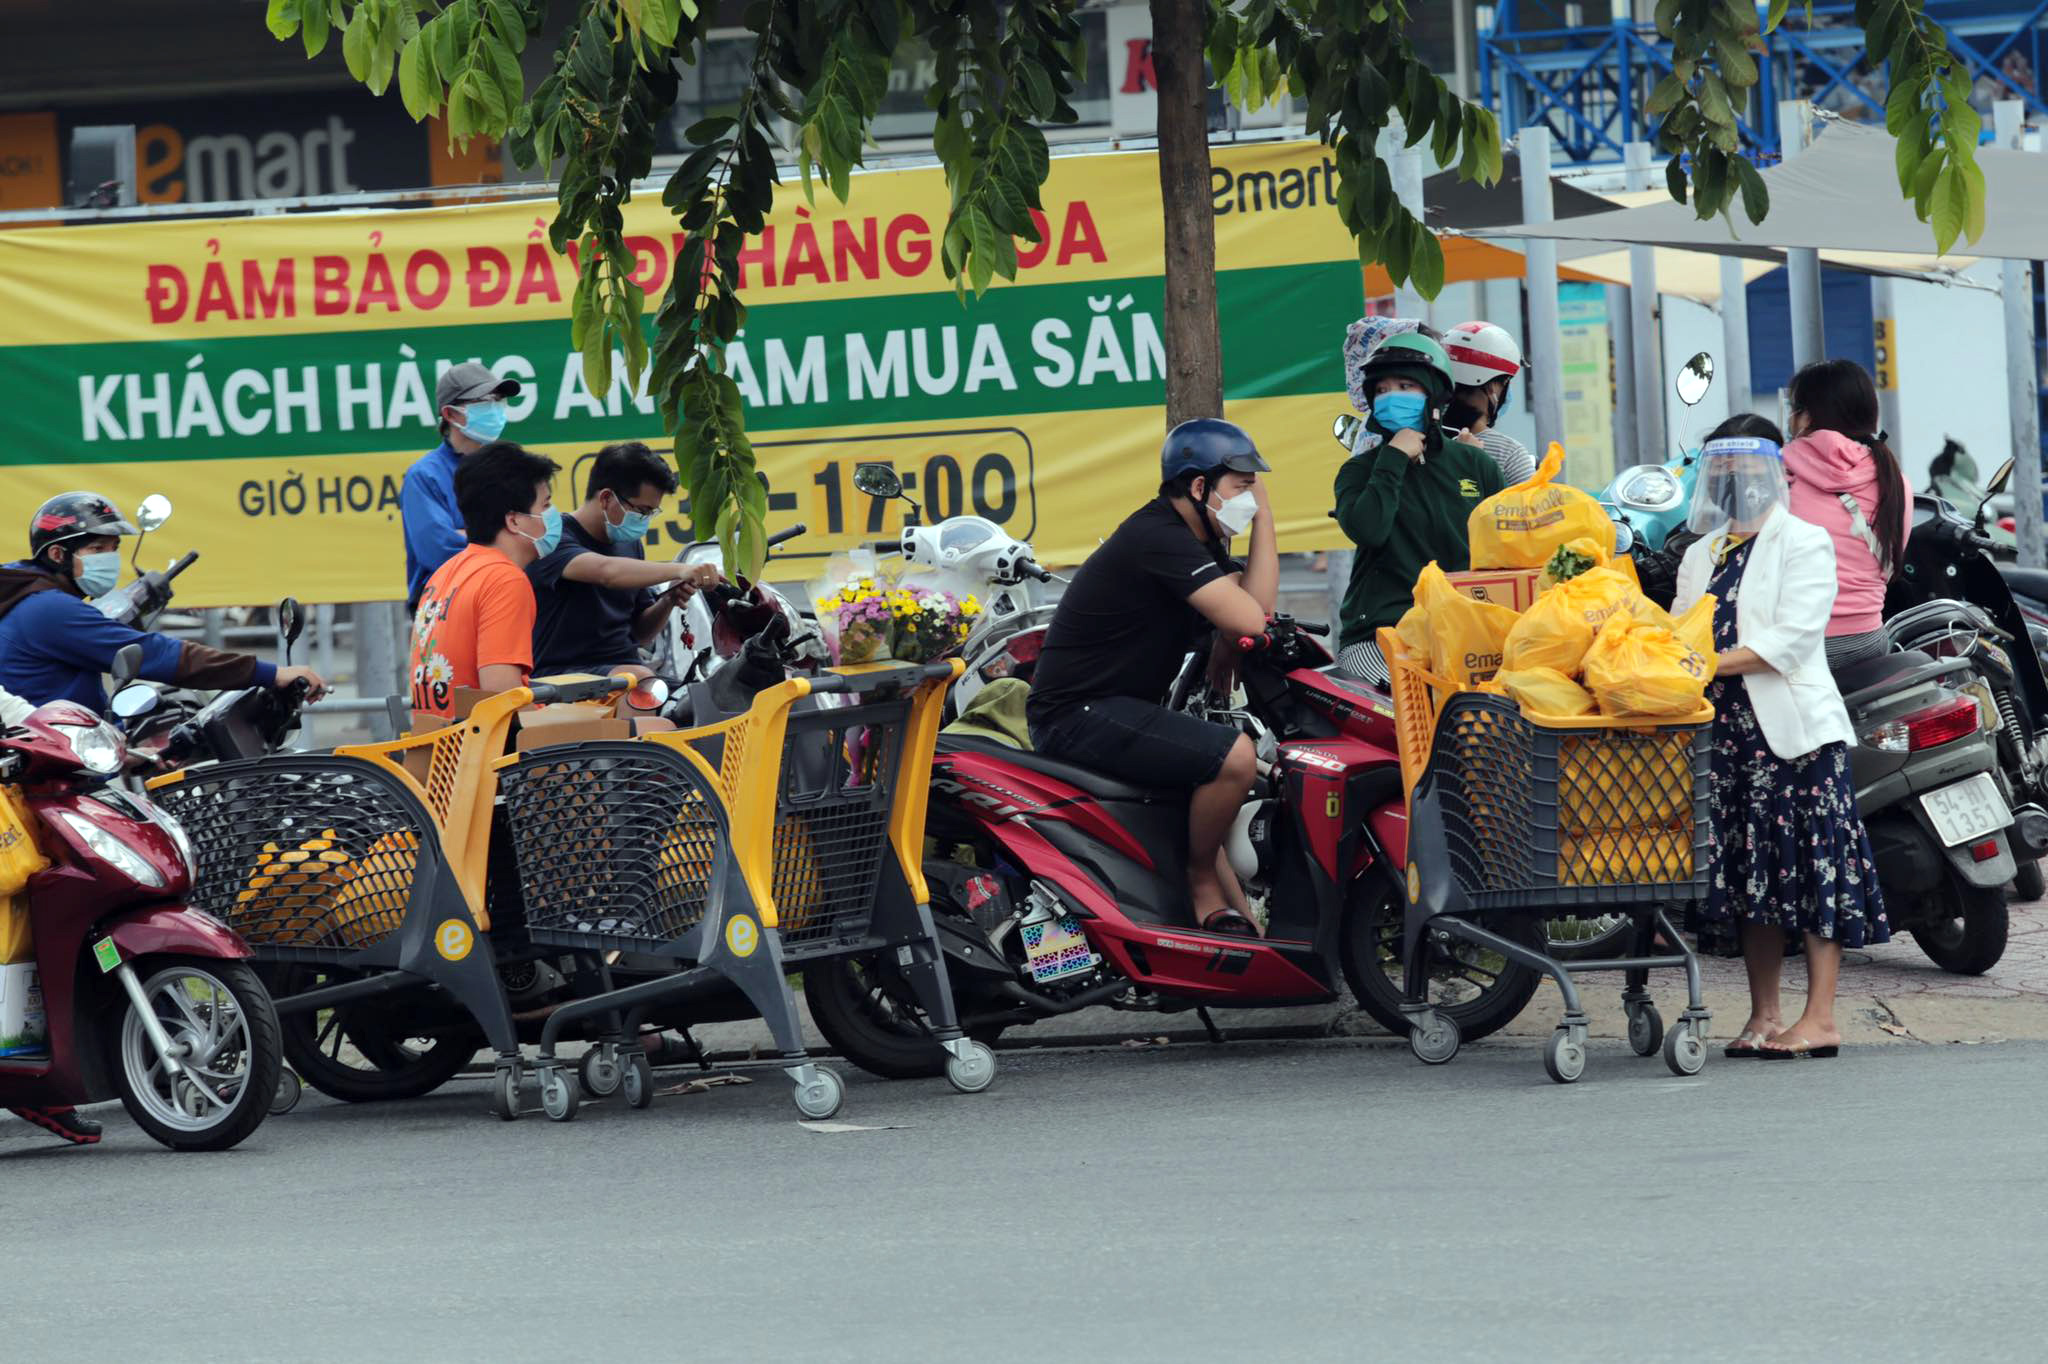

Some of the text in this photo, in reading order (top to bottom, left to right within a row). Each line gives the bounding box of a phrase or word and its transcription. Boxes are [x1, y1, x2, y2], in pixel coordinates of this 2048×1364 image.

[136, 115, 358, 203] emart
[1211, 157, 1337, 215] emart
[145, 237, 297, 324] ĐẢM
[313, 230, 451, 317] BẢO
[736, 205, 933, 289] HÀNG
[79, 353, 321, 441] KHÁCH
[335, 344, 538, 432] HÀG
[845, 323, 1018, 401] MUA
[239, 469, 307, 517] GIỜ
[317, 474, 405, 521] HOẠ
[1285, 749, 1347, 773] 150
[1946, 803, 2000, 839] 1351
